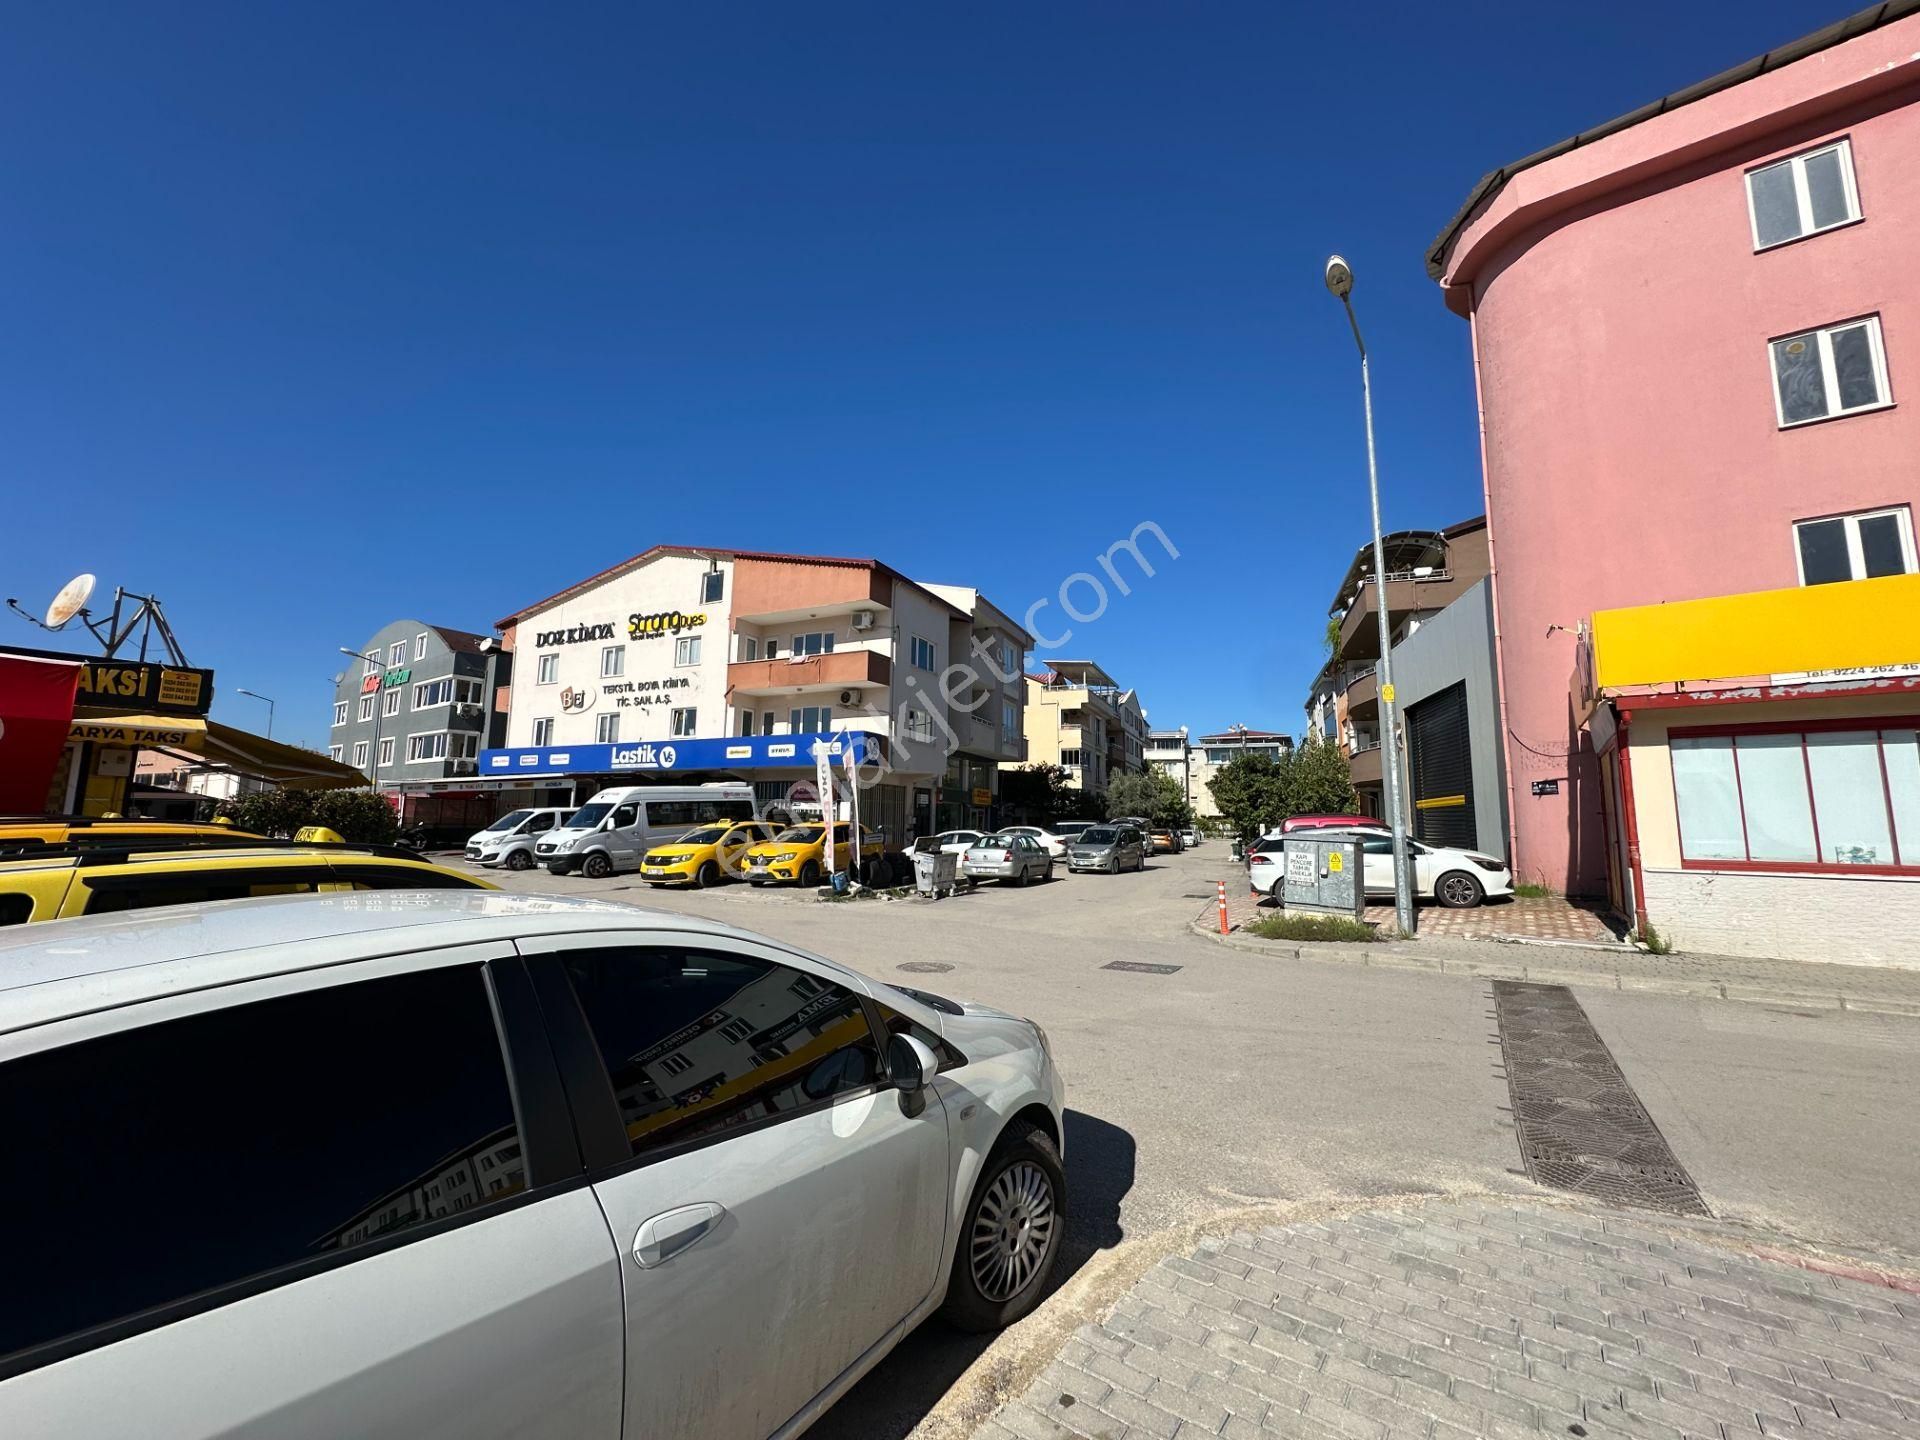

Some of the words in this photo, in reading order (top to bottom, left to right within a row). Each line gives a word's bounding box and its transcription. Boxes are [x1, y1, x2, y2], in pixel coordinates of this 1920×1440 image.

[638, 681, 659, 692] BOYA
[663, 678, 690, 690] KİMYA
[133, 729, 187, 745] TAKSİ
[611, 744, 657, 763] Lastik
